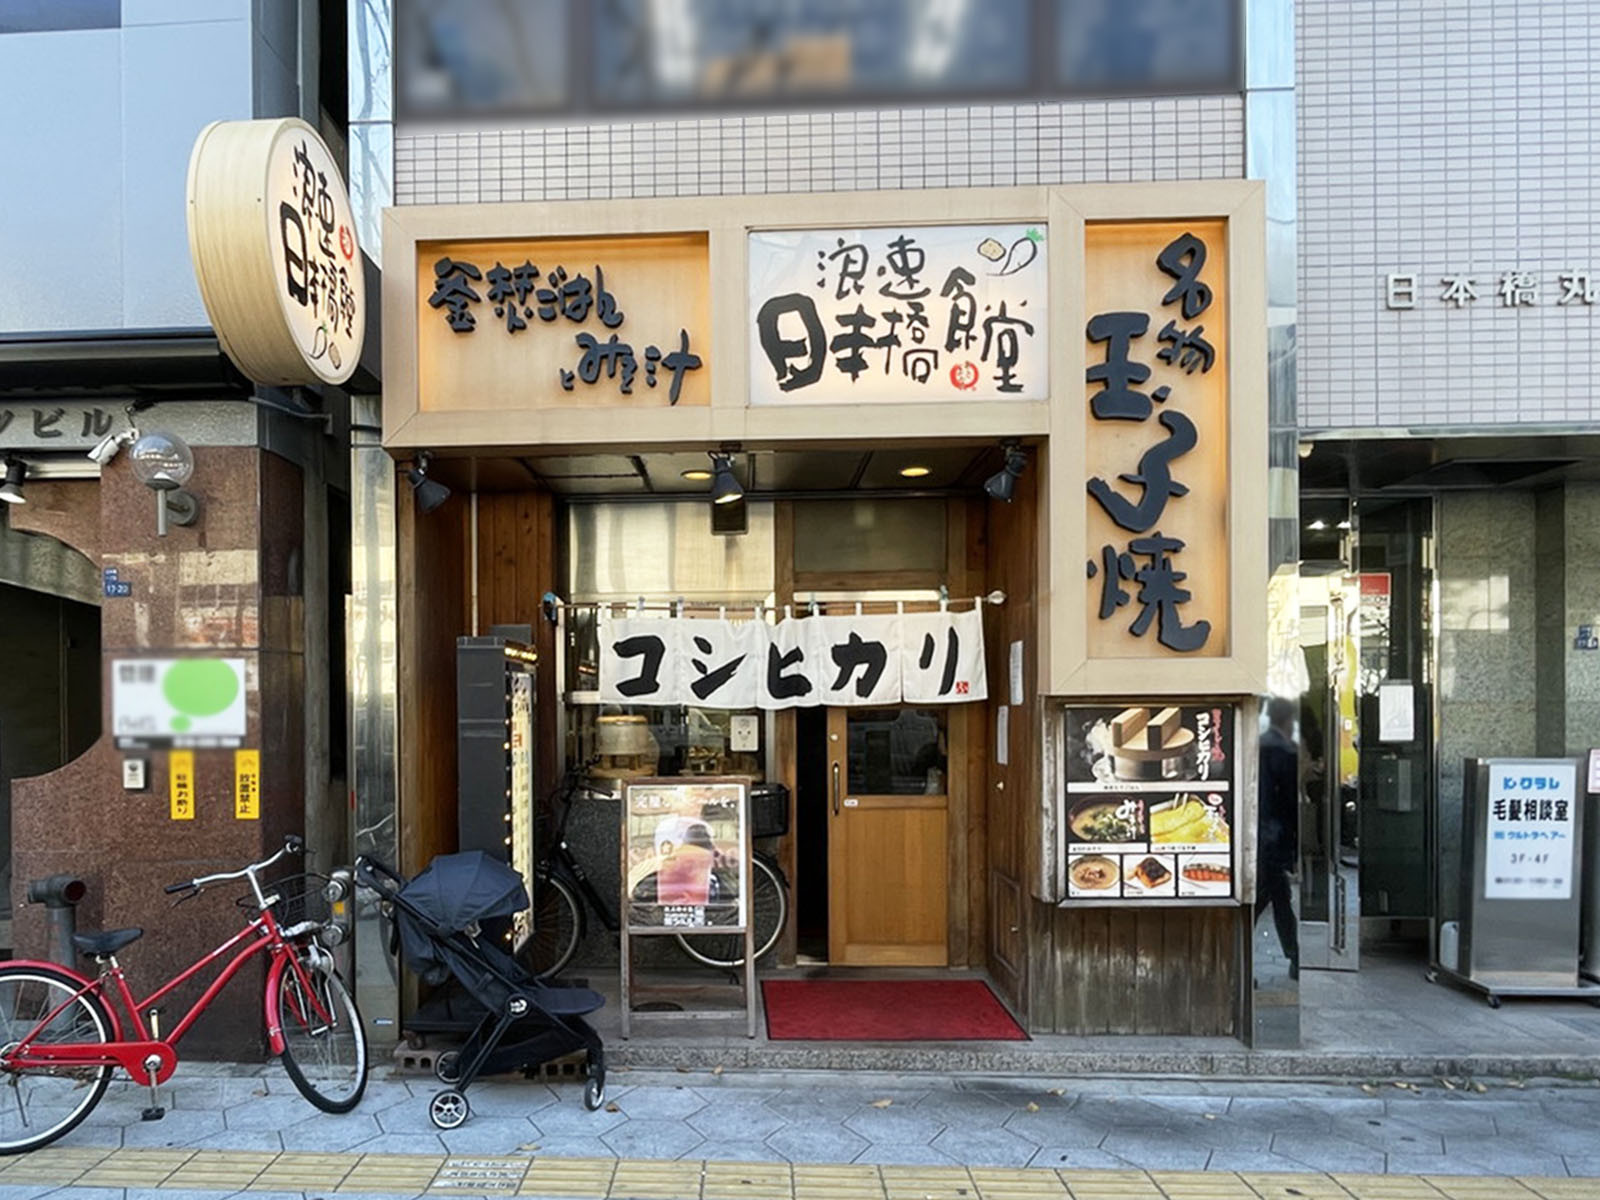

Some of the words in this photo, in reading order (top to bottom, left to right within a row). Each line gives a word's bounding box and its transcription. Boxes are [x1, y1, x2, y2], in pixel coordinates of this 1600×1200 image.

[816, 235, 931, 300] 浪速
[1086, 311, 1212, 652] 玉子焼
[612, 626, 959, 700] コシヒカリ
[1196, 712, 1212, 781] コシヒカリ
